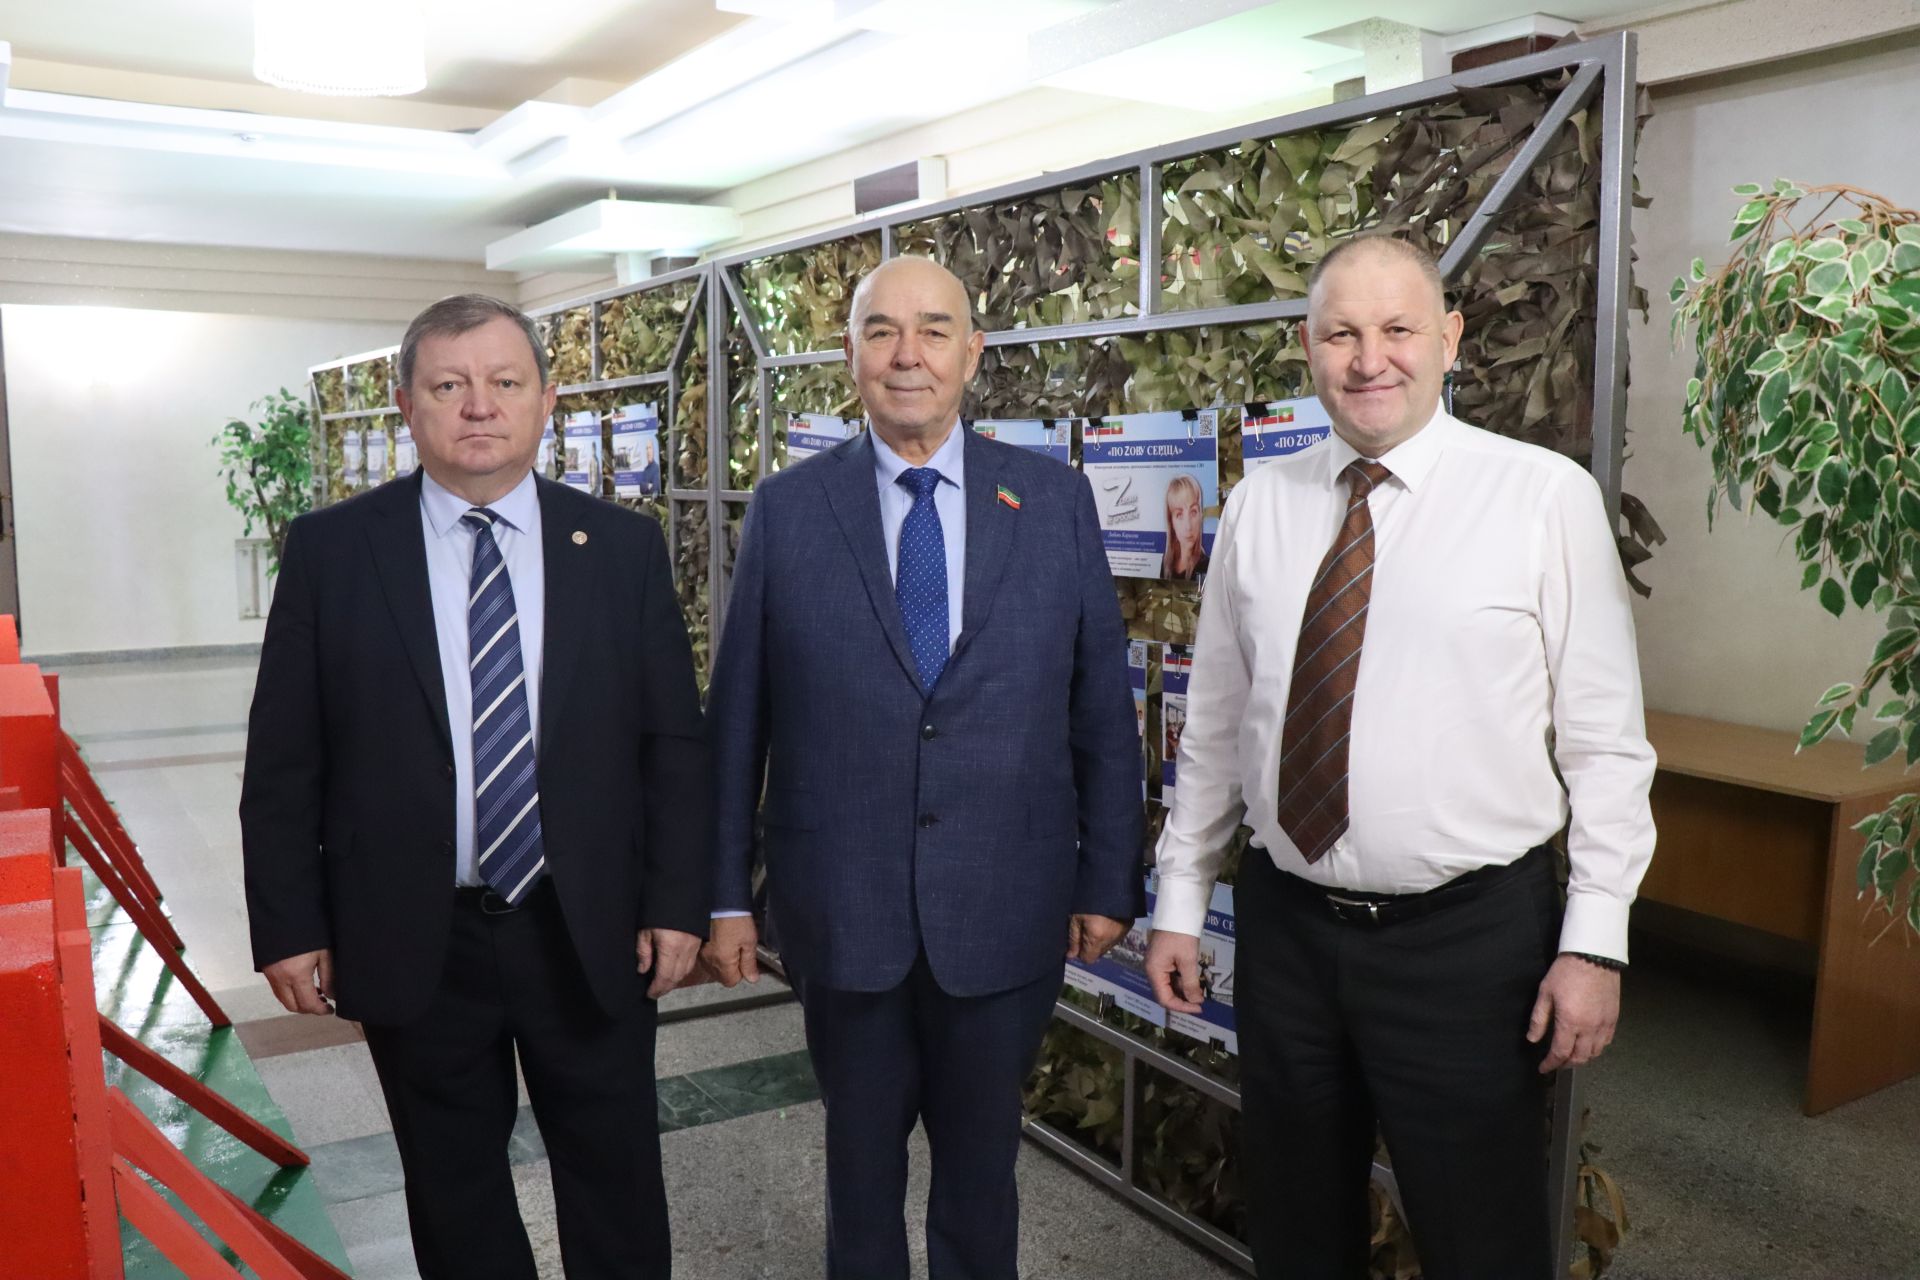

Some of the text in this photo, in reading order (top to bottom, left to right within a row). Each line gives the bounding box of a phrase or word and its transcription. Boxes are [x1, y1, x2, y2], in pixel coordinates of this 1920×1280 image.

[1274, 436, 1295, 449] «ПО
[1107, 445, 1183, 457] «ПО ZОВУ СЕРДЦА»
